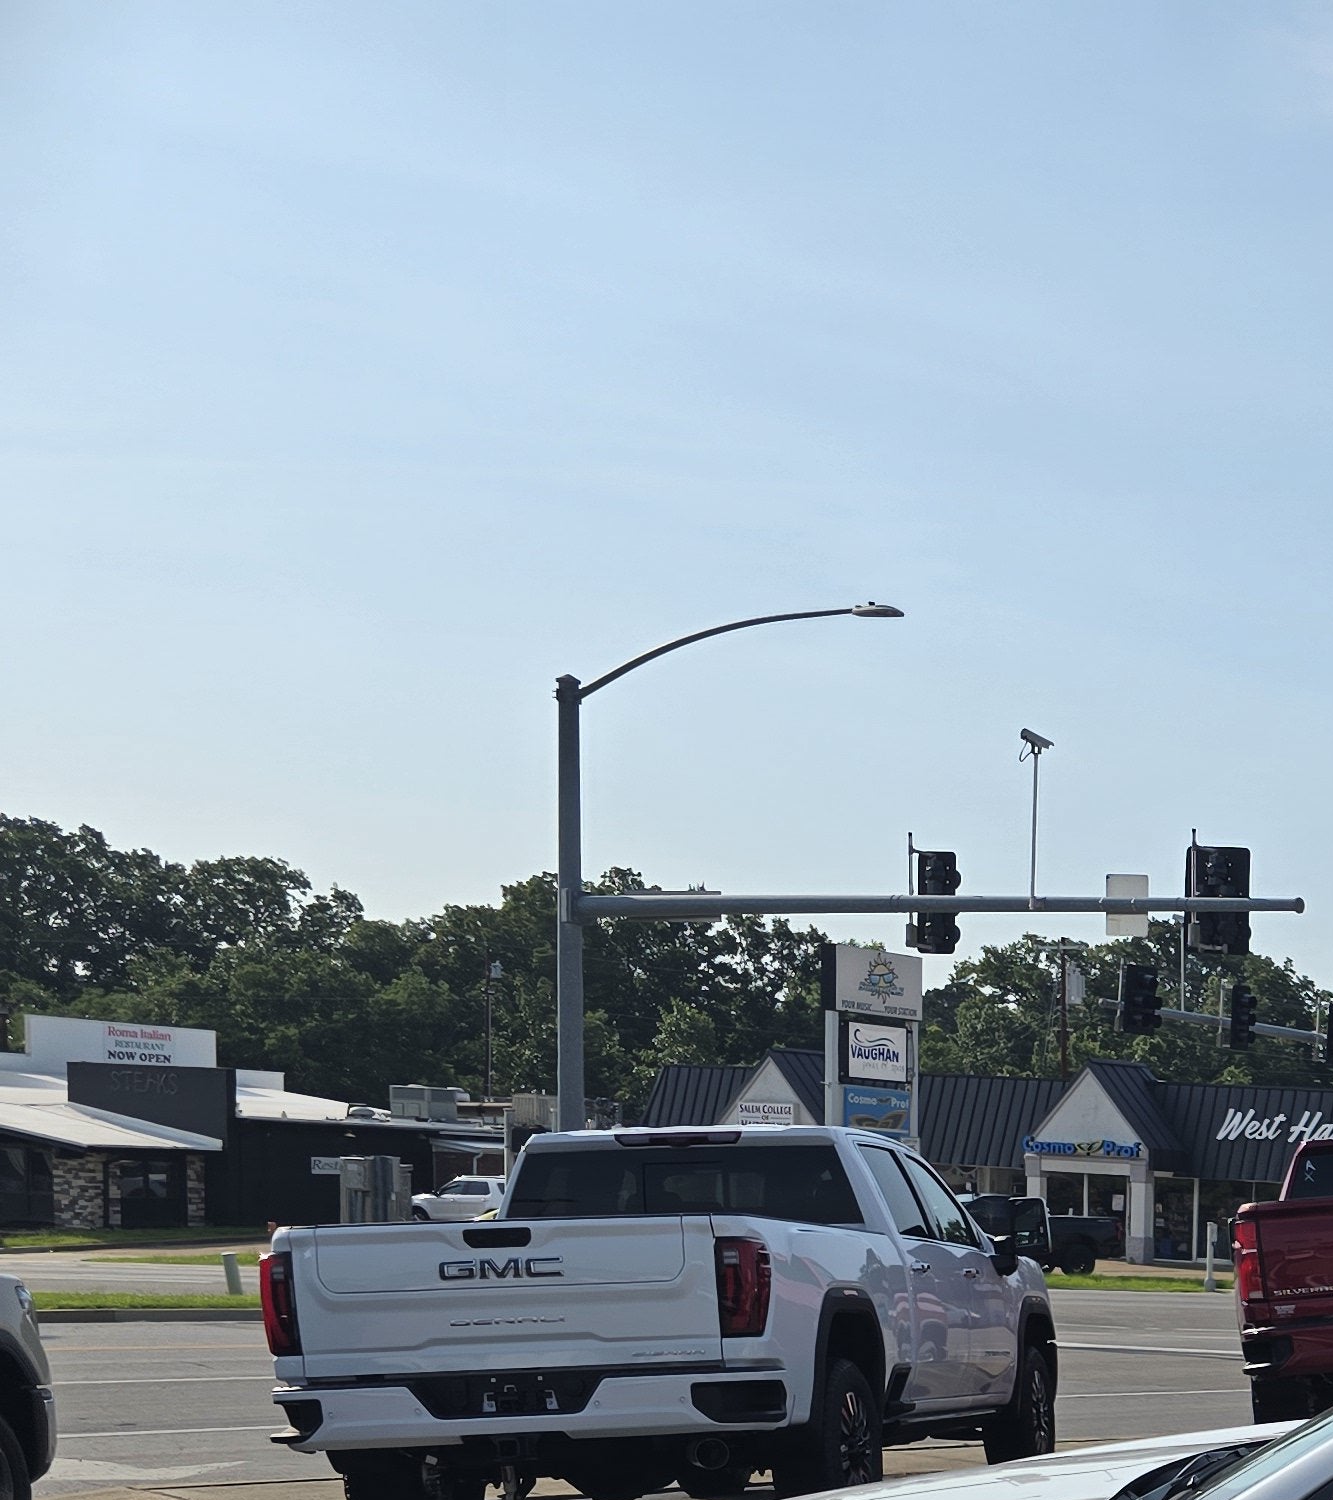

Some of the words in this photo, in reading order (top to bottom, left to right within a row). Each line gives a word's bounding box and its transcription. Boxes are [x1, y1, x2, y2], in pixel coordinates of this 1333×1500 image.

[107, 1025, 138, 1039] Roma
[140, 1028, 172, 1041] Italian
[114, 1039, 165, 1051] RESTAURANT
[107, 1050, 137, 1061] NOW
[139, 1052, 172, 1064] OPEN
[850, 1044, 900, 1063] VAUGHAN
[848, 1092, 878, 1105] Cosmo
[740, 1104, 761, 1114] SALEM
[762, 1104, 792, 1115] COLLEGE
[1216, 1108, 1287, 1141] West
[1022, 1136, 1077, 1156] Cosmo
[1102, 1140, 1142, 1158] Prof
[438, 1256, 564, 1281] GMC
[450, 1315, 566, 1327] DENALI
